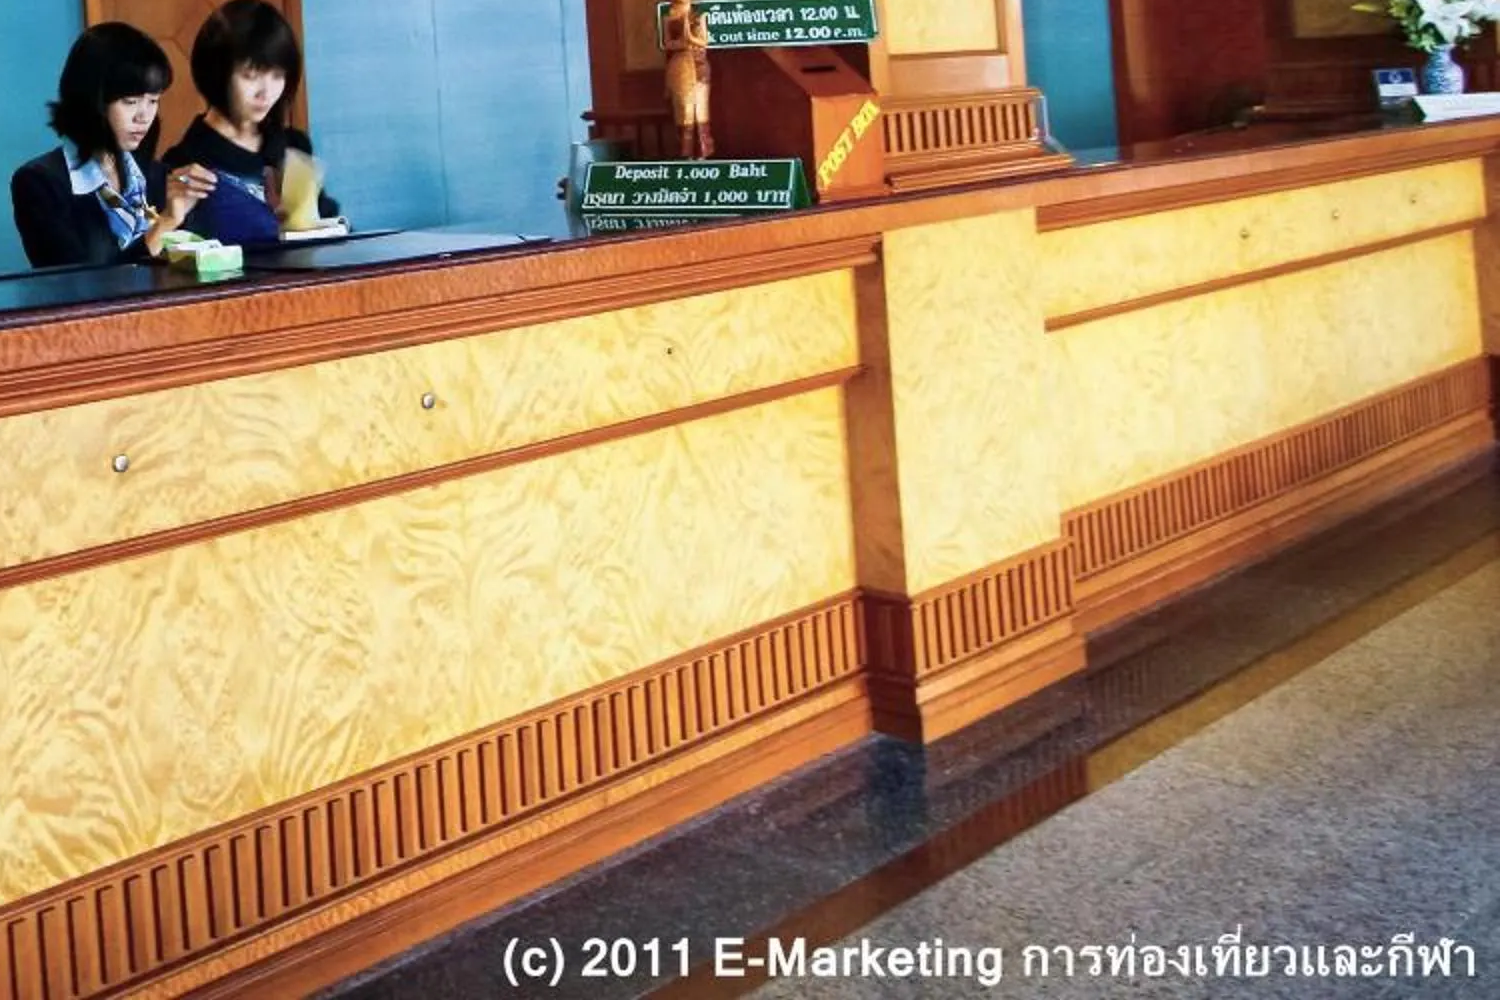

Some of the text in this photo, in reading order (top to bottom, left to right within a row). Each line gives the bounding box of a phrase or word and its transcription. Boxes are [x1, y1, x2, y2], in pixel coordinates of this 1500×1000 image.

[799, 5, 838, 21] 12.00
[719, 31, 744, 43] out
[747, 28, 780, 41] time
[785, 26, 832, 40] 12.00
[818, 127, 852, 188] POST
[615, 165, 670, 182] Deposit
[728, 163, 768, 179] Baht
[704, 189, 749, 205] 1,000
